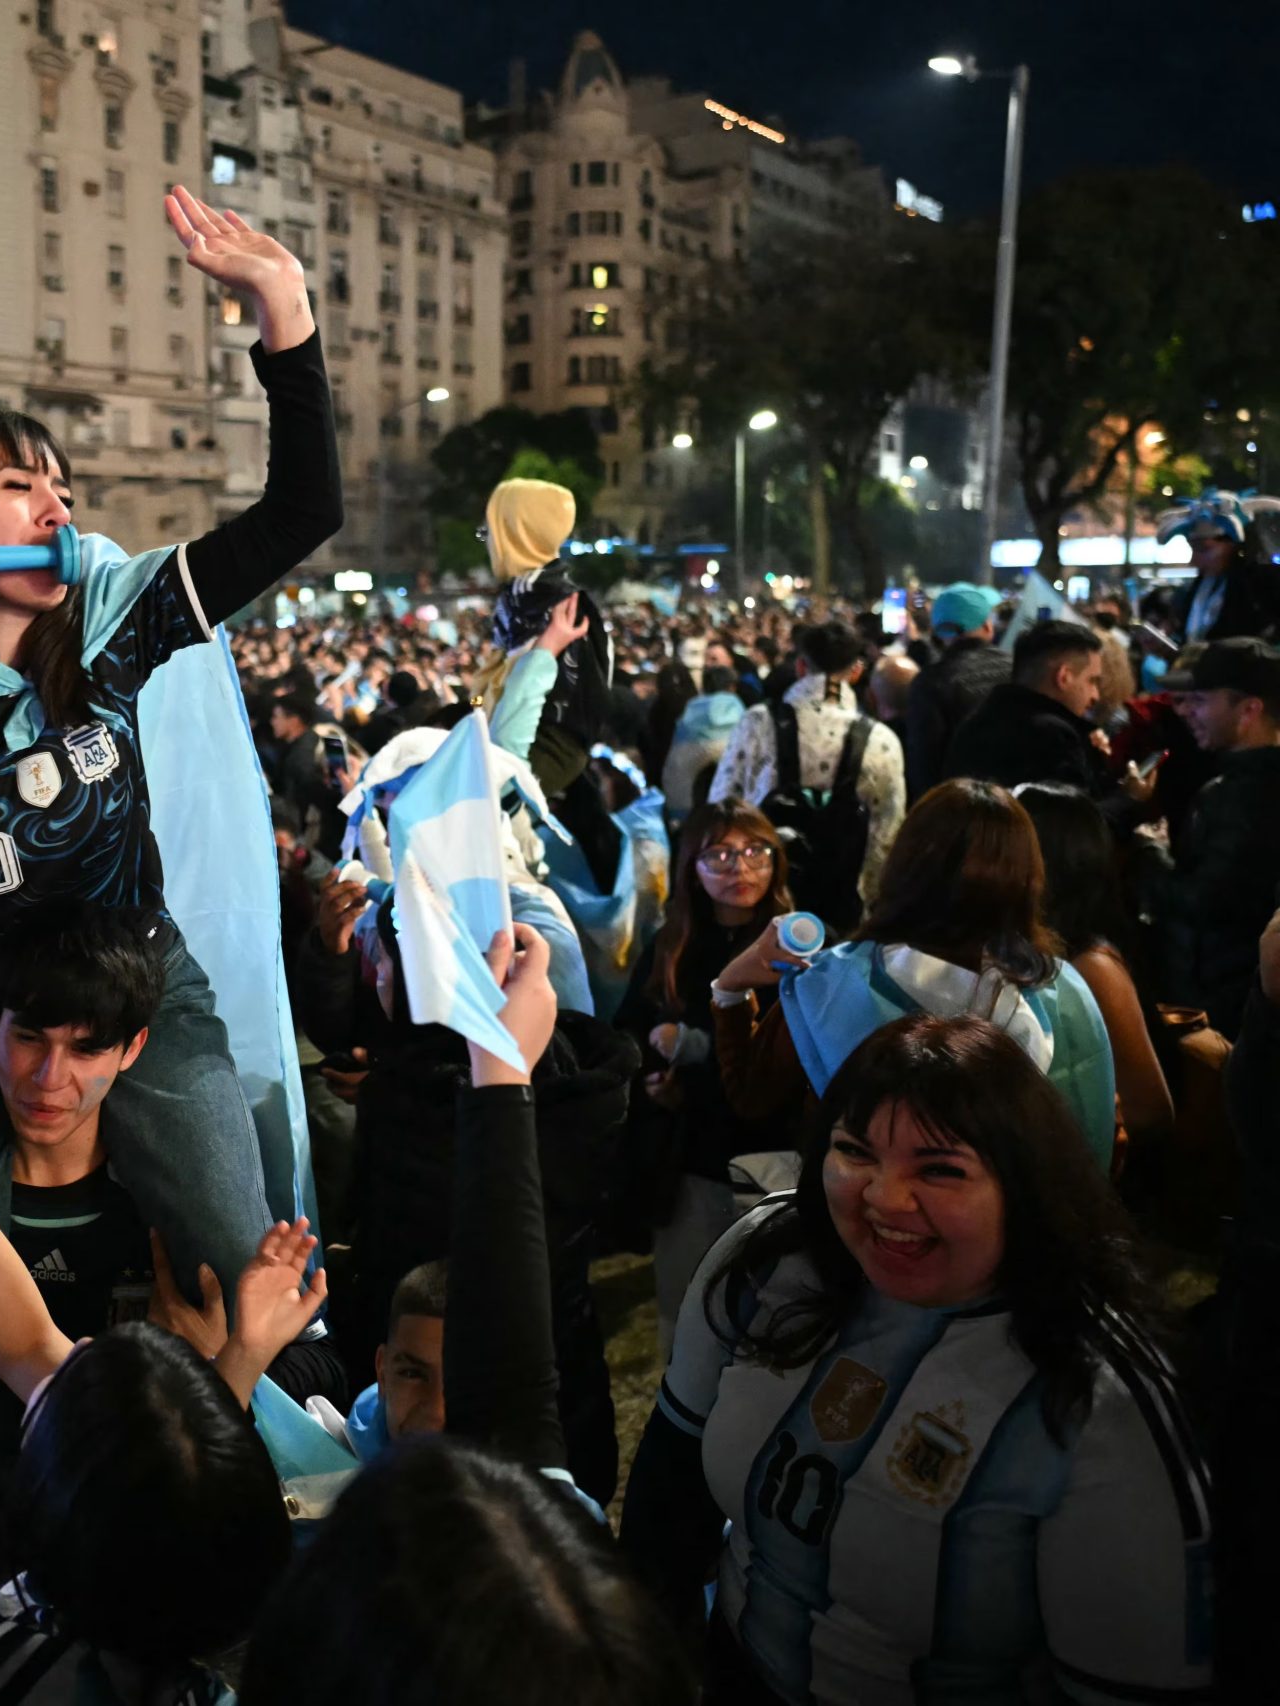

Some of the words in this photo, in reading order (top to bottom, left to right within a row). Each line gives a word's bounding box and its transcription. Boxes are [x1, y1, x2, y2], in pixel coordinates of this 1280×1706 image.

[83, 740, 108, 767] AFA
[30, 1268, 77, 1282] adidas
[759, 1430, 840, 1545] 10
